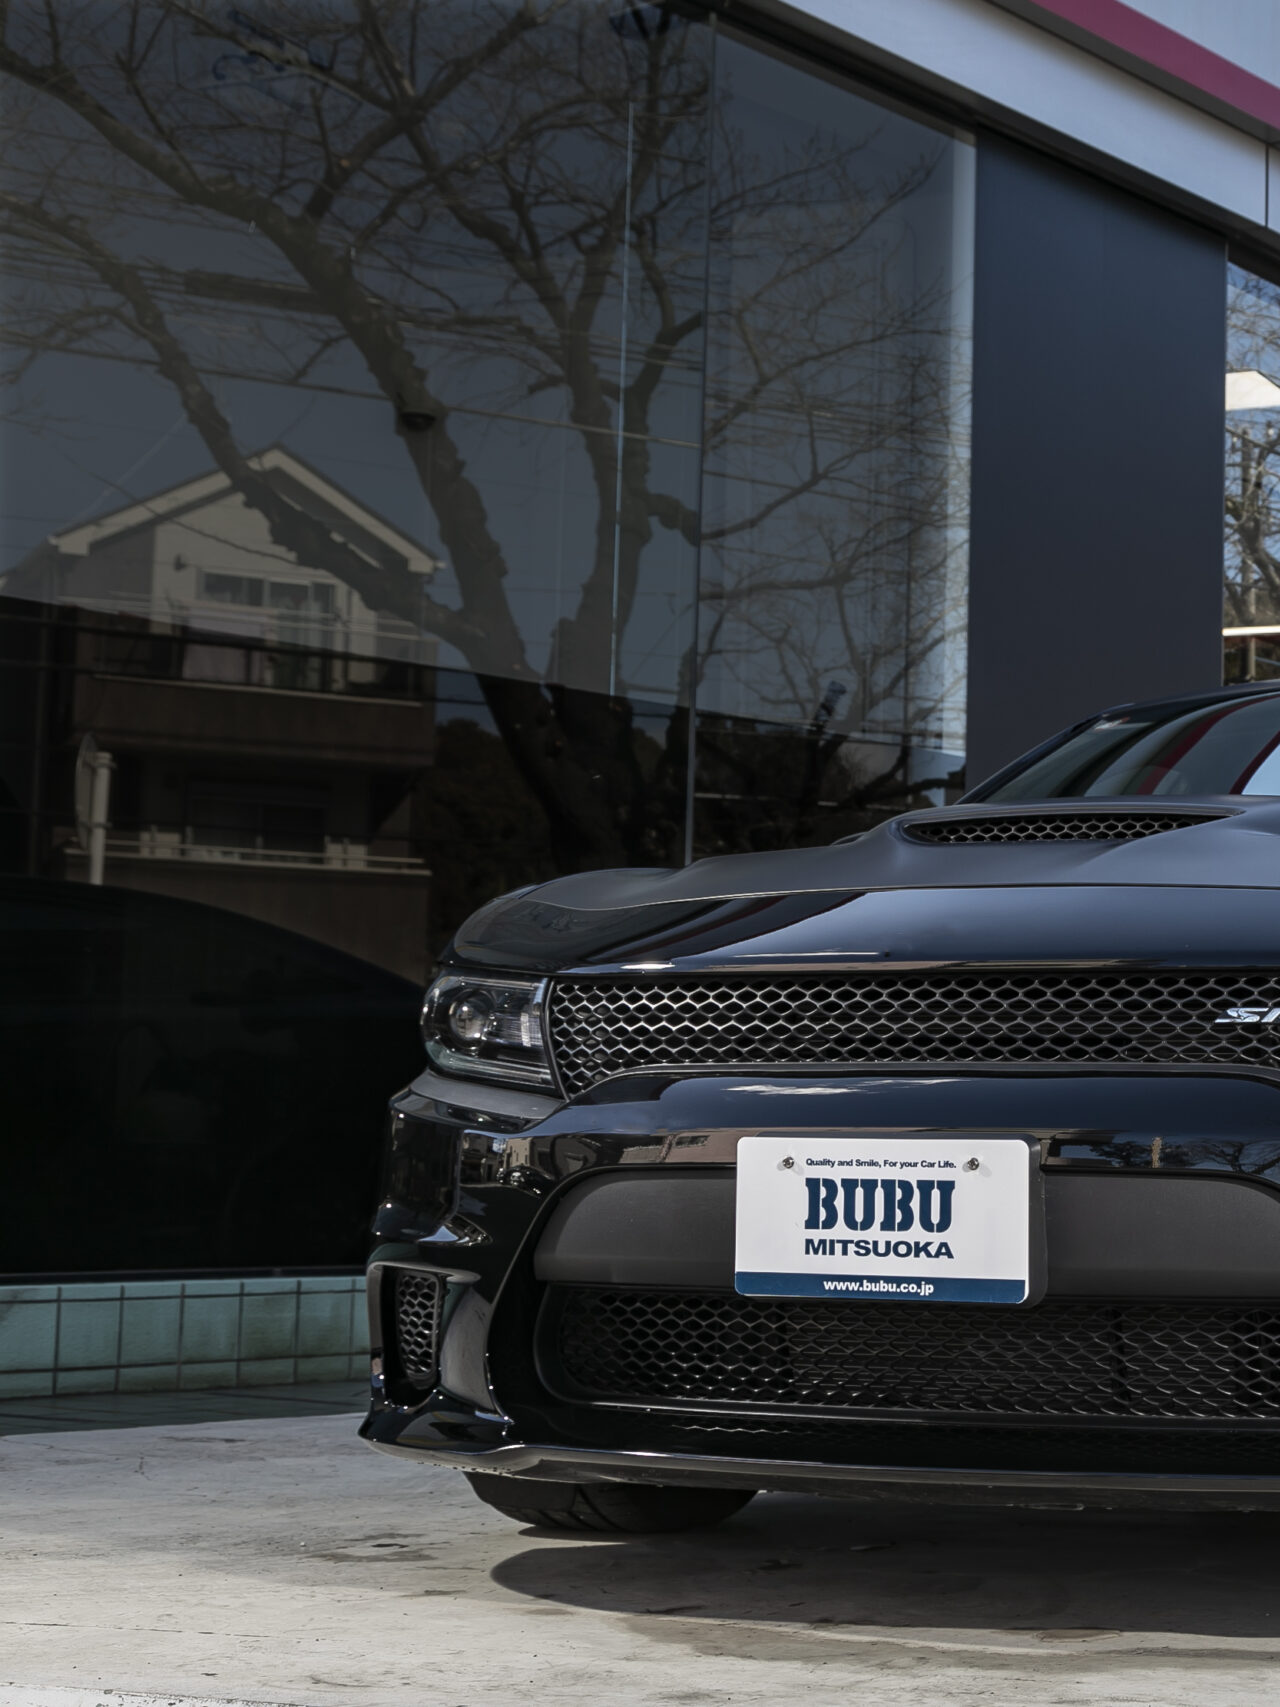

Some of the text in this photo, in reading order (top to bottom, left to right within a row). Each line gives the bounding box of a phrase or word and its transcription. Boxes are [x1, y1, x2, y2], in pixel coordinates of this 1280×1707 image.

[805, 1158, 957, 1169] Quality and Smile, For your Car Life.
[804, 1177, 956, 1233] BUBU
[804, 1238, 955, 1259] MITSUOKA
[823, 1279, 935, 1296] www.bubu.co.jp
